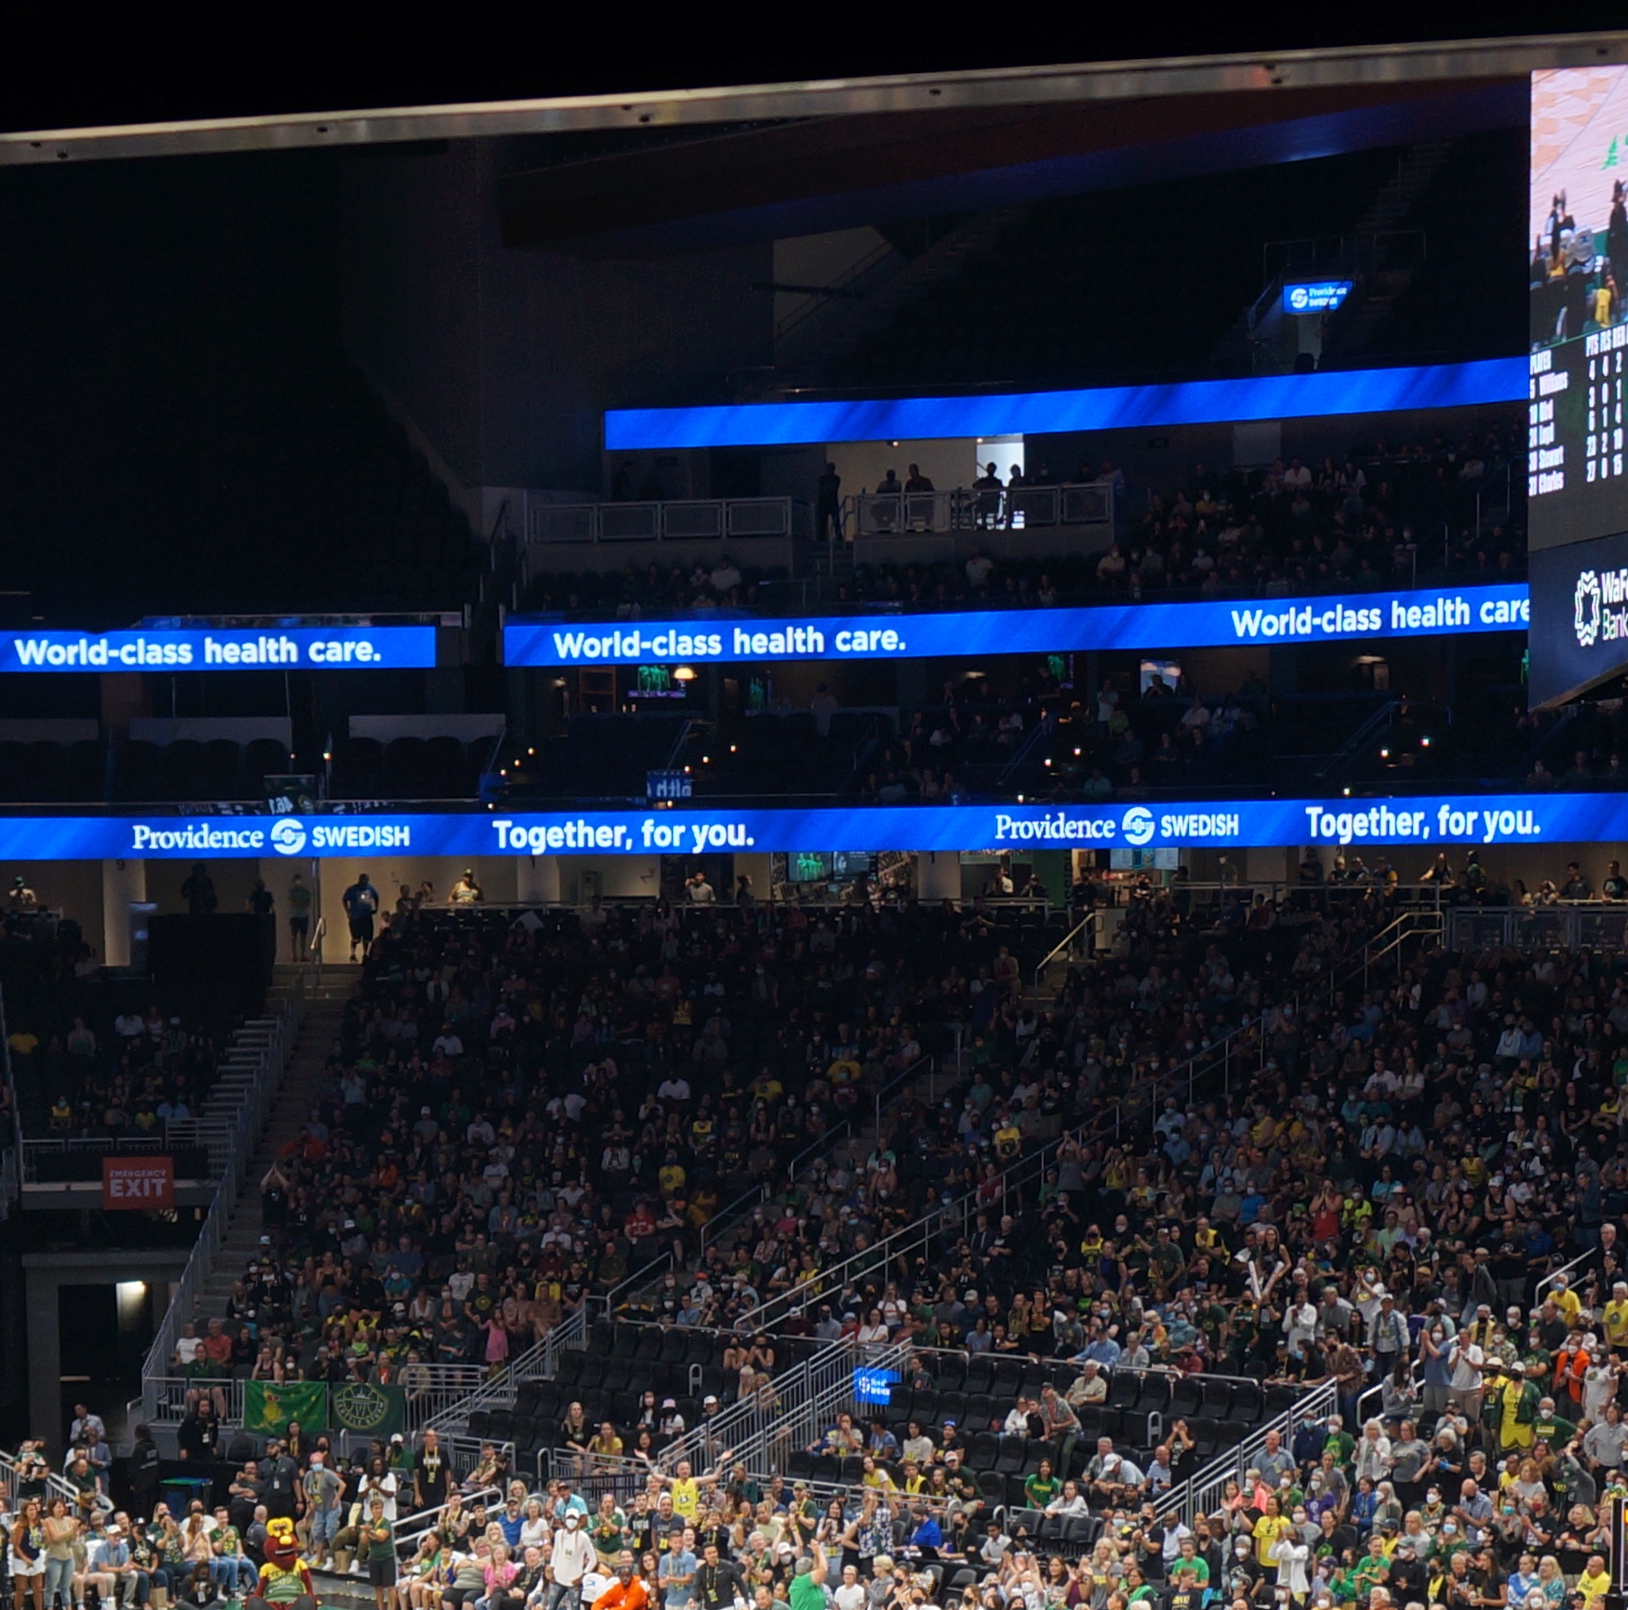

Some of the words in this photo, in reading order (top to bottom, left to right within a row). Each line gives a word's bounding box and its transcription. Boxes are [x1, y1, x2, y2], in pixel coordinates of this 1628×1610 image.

[1232, 604, 1381, 637] World-class
[1392, 597, 1470, 629] health
[14, 639, 192, 665] World-class
[205, 636, 298, 663] health
[309, 641, 381, 662] care.
[552, 629, 725, 661] World-class
[734, 626, 824, 654] health
[836, 630, 905, 651] care.
[133, 823, 264, 849] Providence
[312, 826, 410, 847] SWEDISH
[493, 820, 632, 855] Together,
[642, 819, 686, 846] for
[692, 824, 754, 854] you.
[995, 812, 1115, 839] Providence
[1161, 814, 1238, 837] SWEDISH
[1306, 806, 1429, 844] Together,
[1438, 805, 1478, 835] for
[1484, 810, 1540, 843] you.
[109, 1169, 167, 1178] EMERGENCY
[109, 1178, 167, 1198] EXIT
